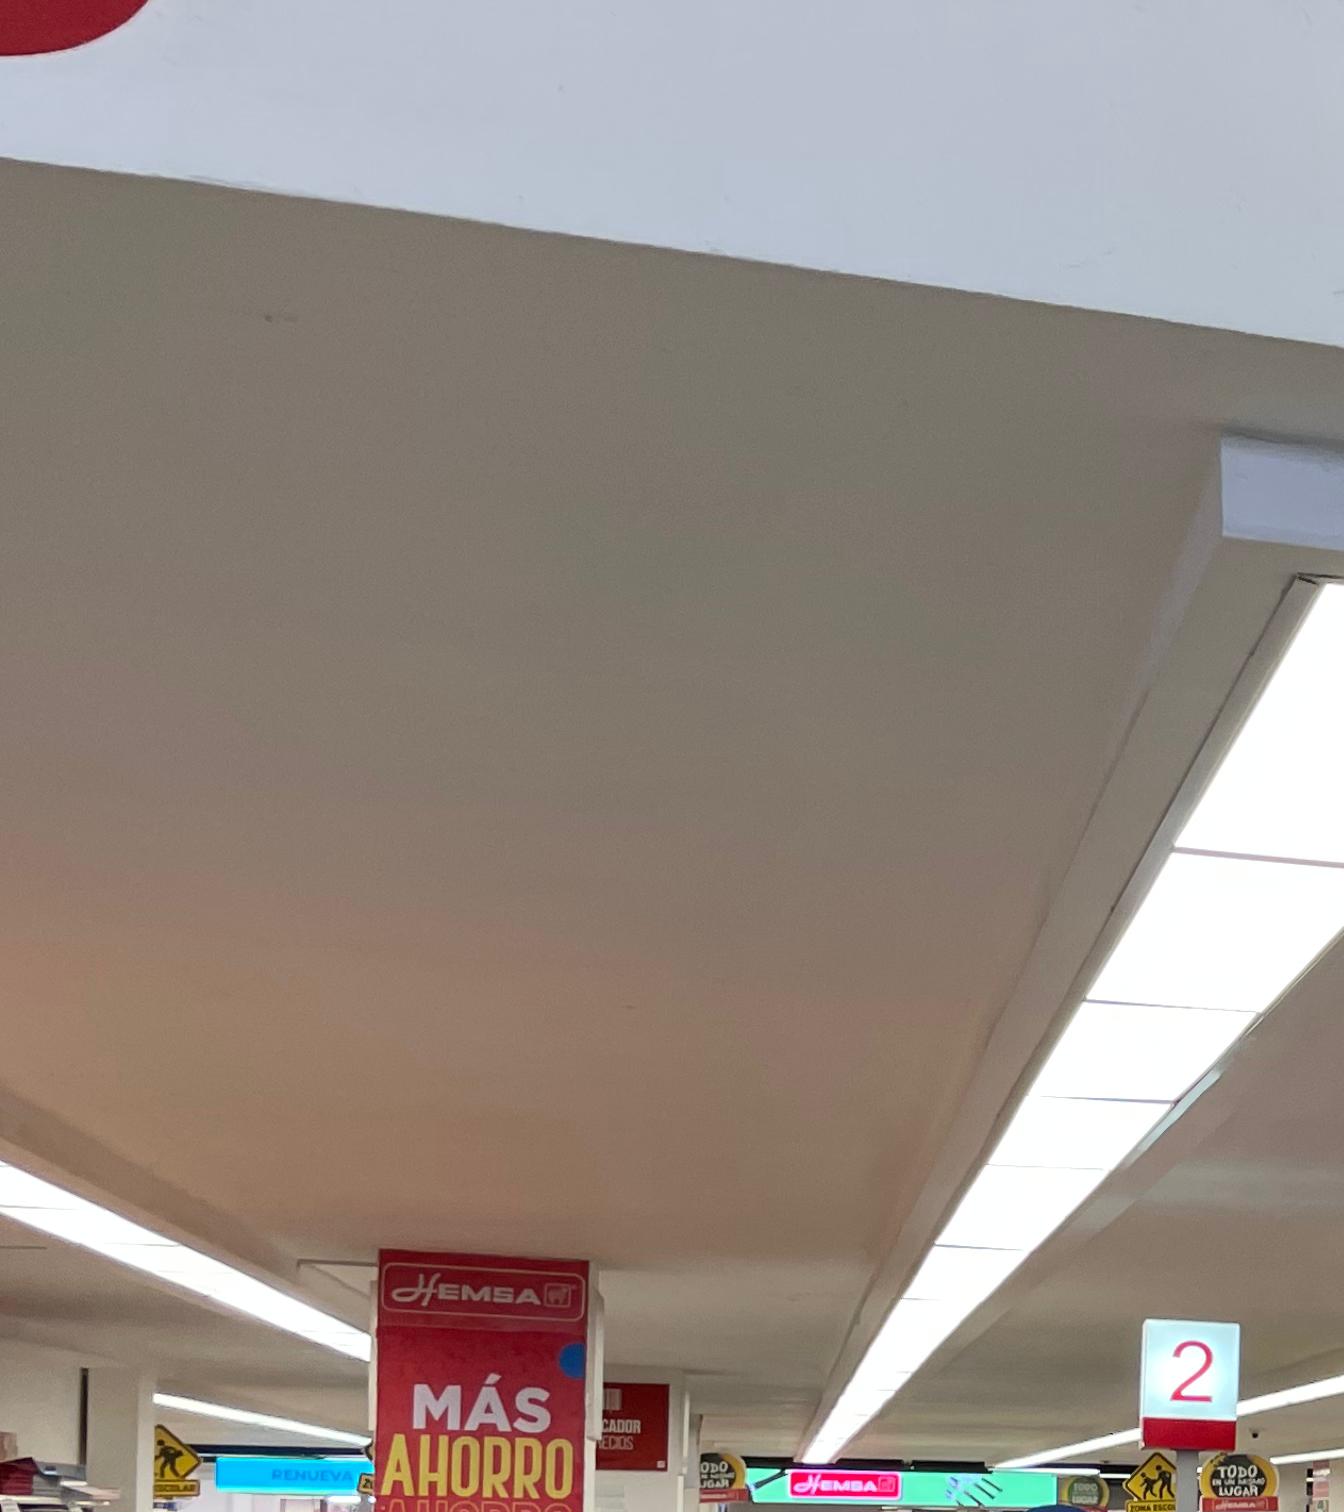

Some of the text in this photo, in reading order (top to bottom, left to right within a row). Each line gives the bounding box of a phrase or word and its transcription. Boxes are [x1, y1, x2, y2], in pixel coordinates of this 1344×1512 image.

[391, 1272, 542, 1306] HEMSA
[1170, 1340, 1213, 1402] 2
[412, 1372, 552, 1433] MÁS
[272, 1468, 353, 1482] RENUEVA
[381, 1434, 574, 1499] AHORRO
[1217, 1464, 1258, 1478] TODO
[793, 1474, 877, 1496] HEMSA
[1218, 1485, 1258, 1497] LUGAR
